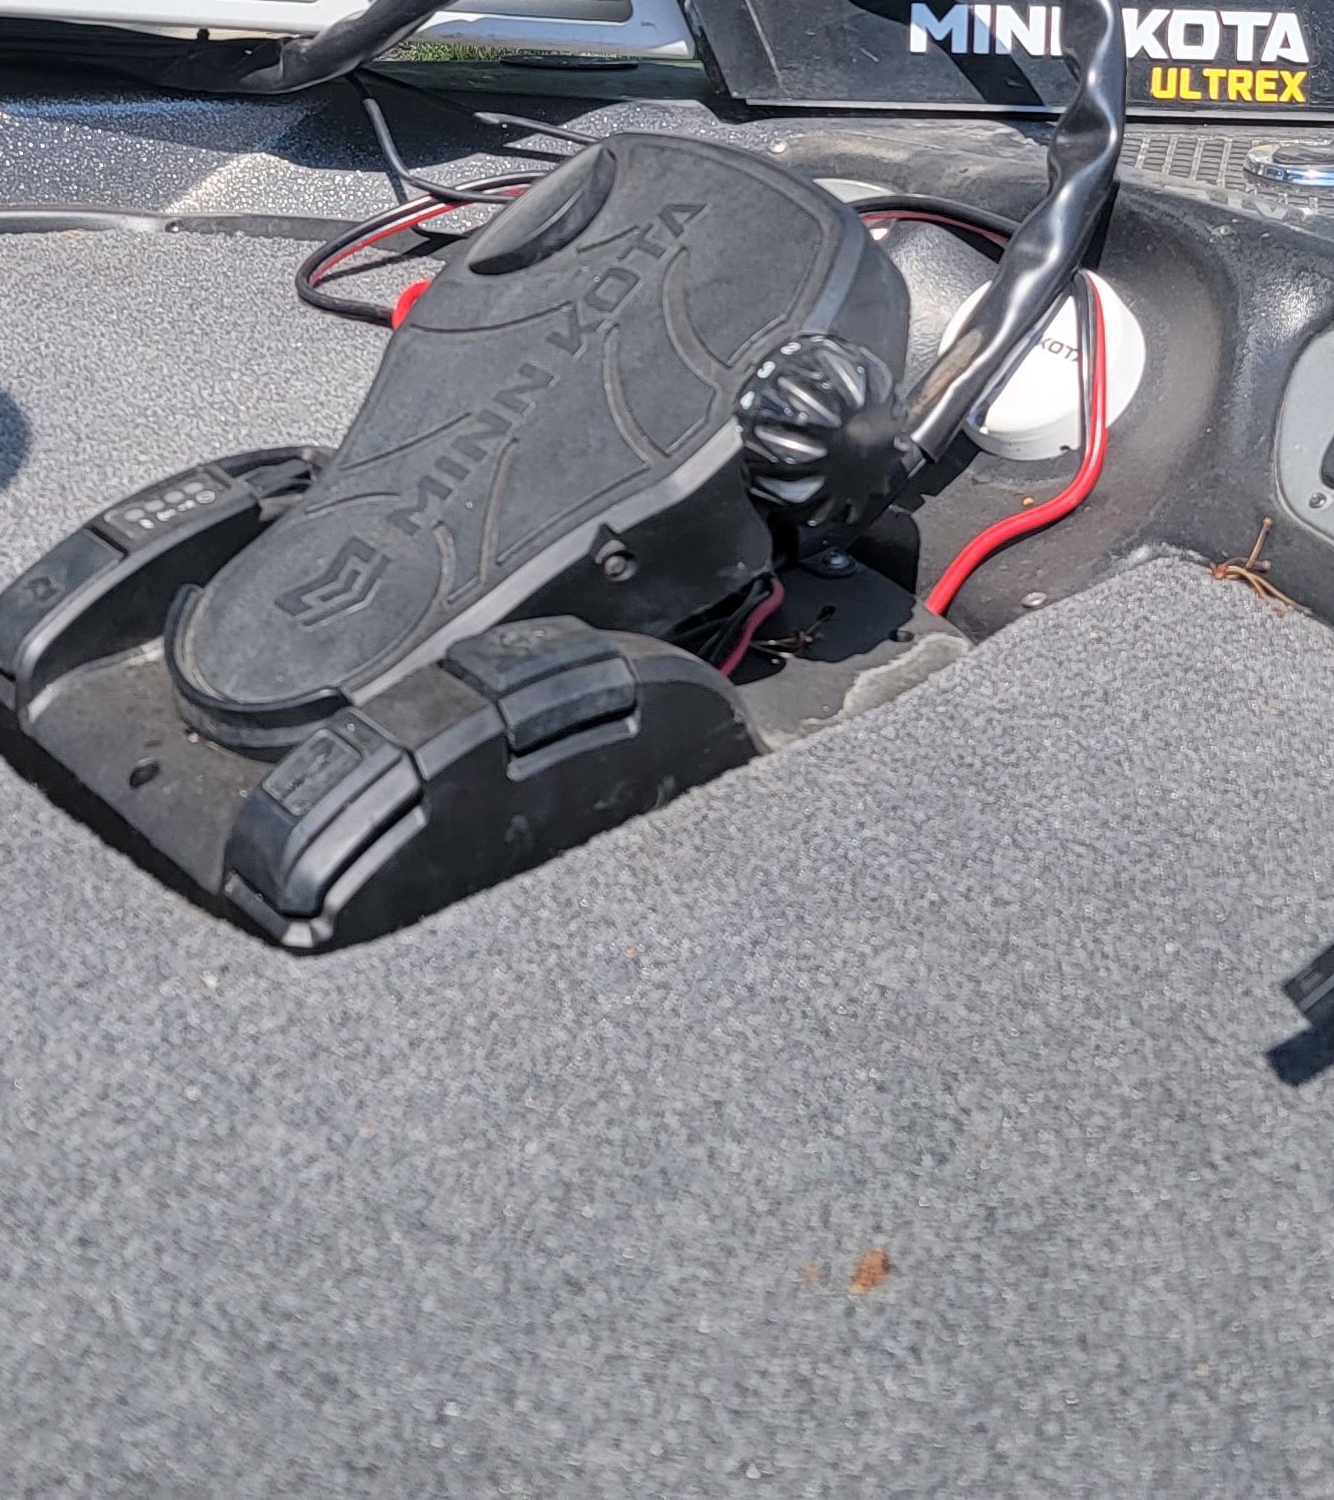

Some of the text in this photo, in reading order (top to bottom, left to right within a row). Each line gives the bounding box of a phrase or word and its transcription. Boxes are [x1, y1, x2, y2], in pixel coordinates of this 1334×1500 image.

[1121, 7, 1309, 64] KOTA
[1151, 66, 1307, 104] ULTREX
[386, 202, 710, 537] MINN KOTA
